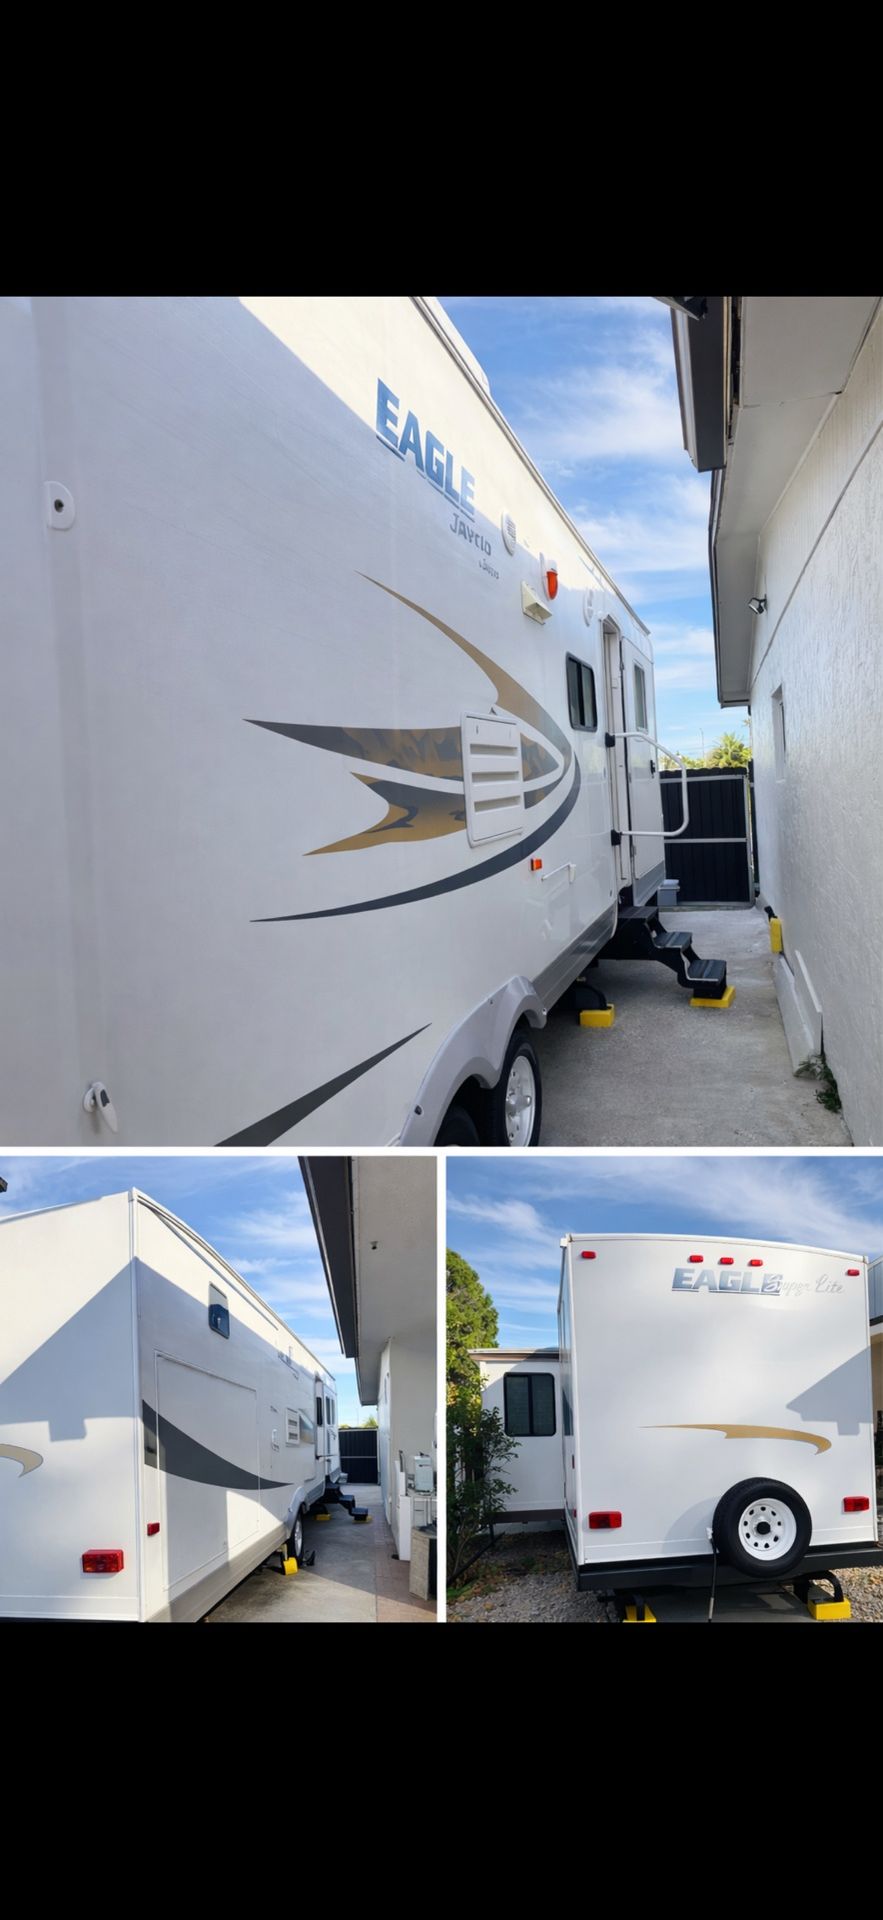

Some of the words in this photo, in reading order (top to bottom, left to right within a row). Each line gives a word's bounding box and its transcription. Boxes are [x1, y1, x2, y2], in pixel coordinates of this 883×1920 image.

[376, 377, 476, 517] EAGLE
[672, 1267, 784, 1293] EAGLE
[815, 1273, 846, 1294] Lite
